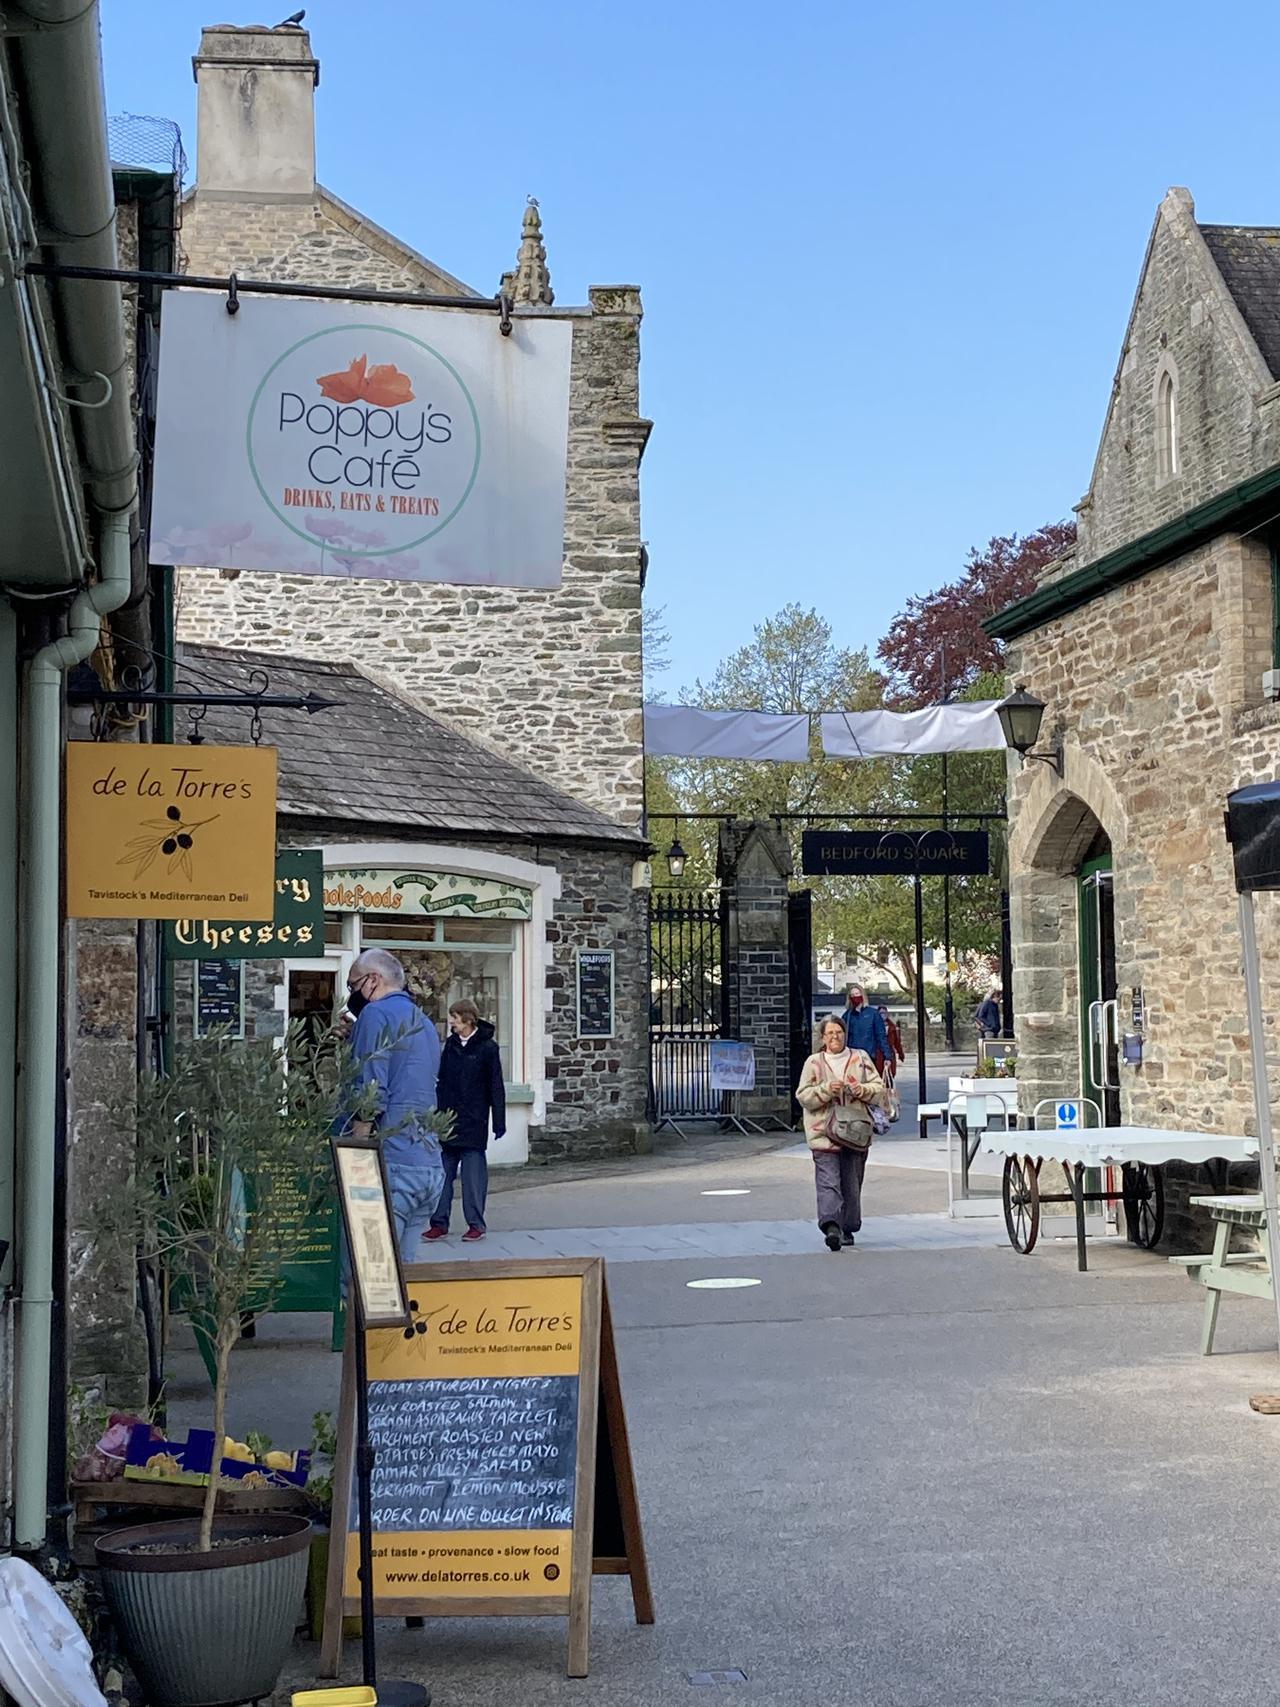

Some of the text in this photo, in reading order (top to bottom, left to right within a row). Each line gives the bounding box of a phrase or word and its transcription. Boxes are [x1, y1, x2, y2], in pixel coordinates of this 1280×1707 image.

[280, 392, 452, 453] Poppy's
[284, 487, 439, 516] DRINKS, EATS & TREATS
[92, 766, 252, 799] de la Torre's
[821, 847, 968, 860] BEDFORD SQUARE
[88, 889, 249, 902] Tavistock's Mediterranean Deli
[175, 920, 315, 950] Cheeses
[439, 1305, 573, 1335] de la Torre's
[438, 1342, 573, 1355] Tavistock's Mediterranean Deli
[367, 1381, 413, 1396] FRIDAY
[417, 1379, 489, 1392] SATURDAY
[401, 1400, 461, 1412] ROASTED
[467, 1397, 518, 1410] SALMON
[440, 1427, 504, 1445] ROASTED
[511, 1427, 547, 1442] NEW
[374, 1447, 438, 1465] OTATOES,
[519, 1443, 560, 1458] MAYO
[357, 1507, 413, 1525] RDER
[391, 1546, 418, 1557] taste
[428, 1547, 494, 1559] provenance
[504, 1545, 530, 1557] slow
[533, 1545, 559, 1556] food
[385, 1569, 530, 1582] www.delatorres.co.uk
